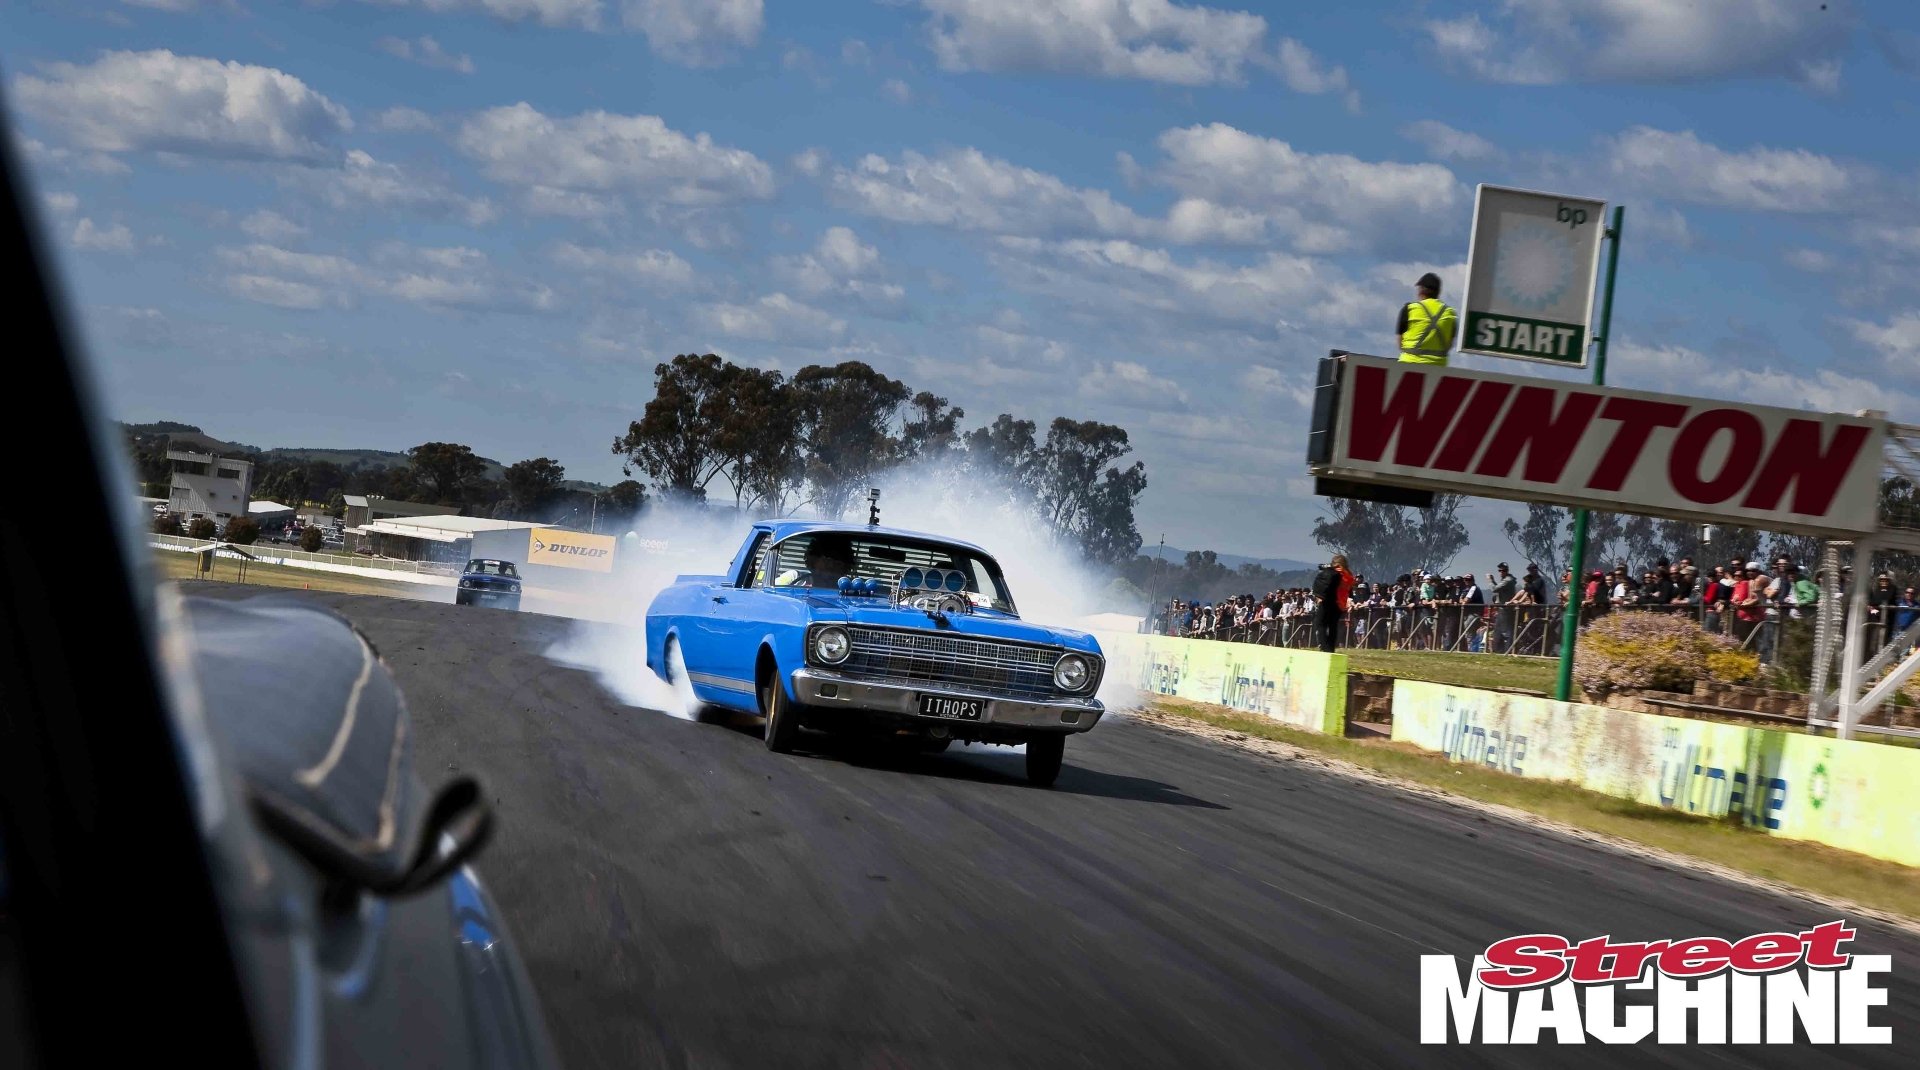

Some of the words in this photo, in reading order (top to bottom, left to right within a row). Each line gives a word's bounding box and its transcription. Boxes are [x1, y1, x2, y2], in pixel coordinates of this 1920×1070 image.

[1557, 202, 1588, 230] bp
[1475, 318, 1576, 356] START
[1347, 365, 1873, 517] WINTON
[548, 543, 608, 558] DUNLOP
[926, 698, 977, 717] ITHOPS
